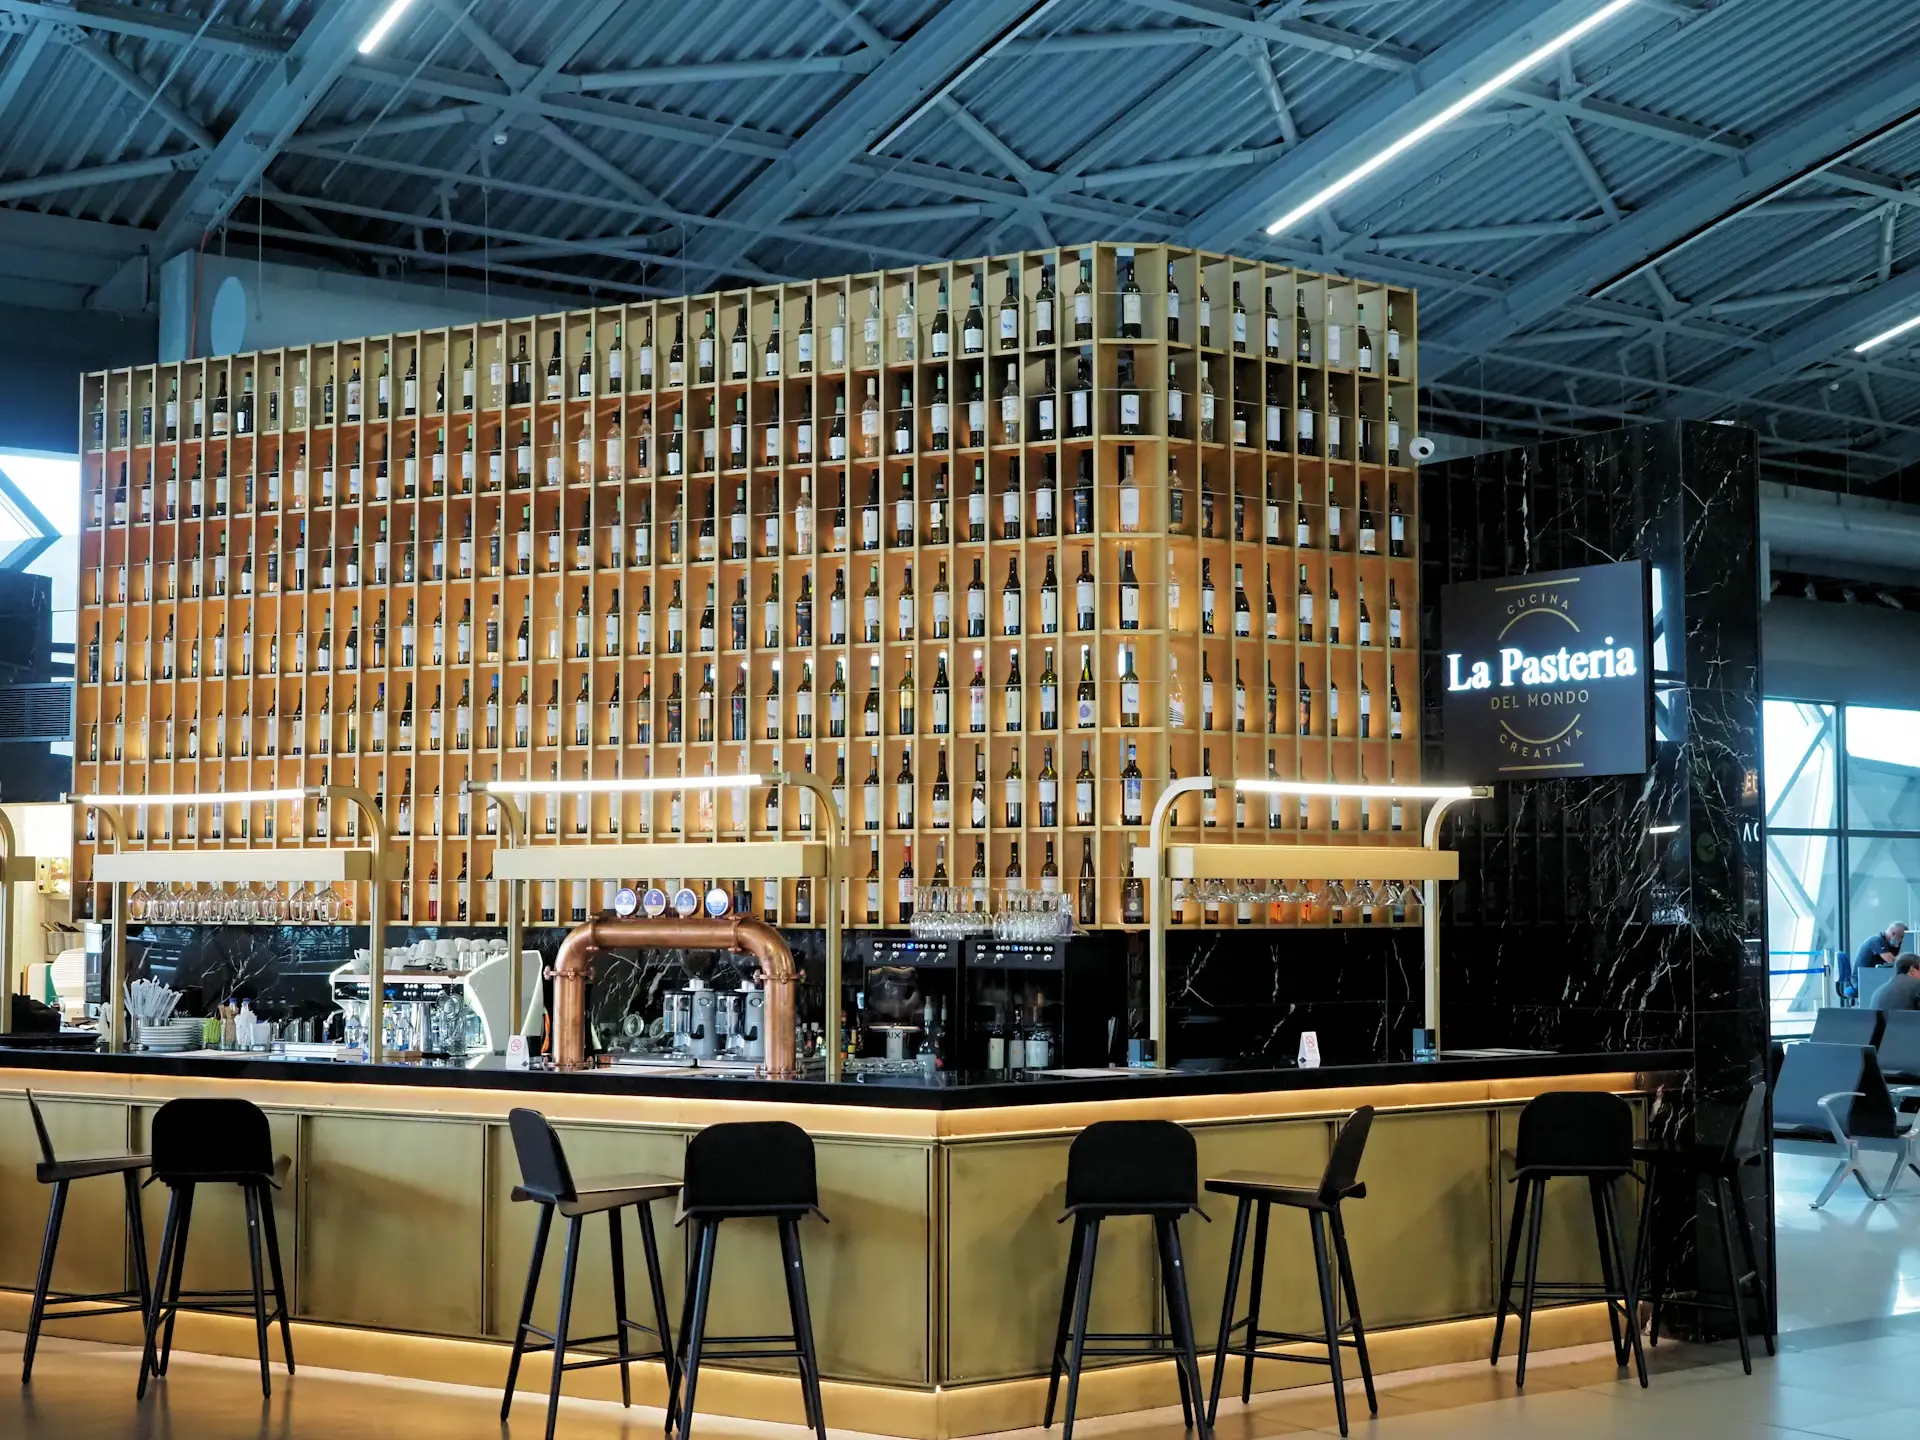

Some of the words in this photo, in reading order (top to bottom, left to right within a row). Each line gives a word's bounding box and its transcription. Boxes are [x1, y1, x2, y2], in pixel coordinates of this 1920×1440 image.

[1507, 593, 1569, 615] CUCINA
[1447, 653, 1491, 691] La
[1500, 636, 1637, 687] Pasteria
[1491, 696, 1520, 710] DEL
[1528, 689, 1589, 707] MONDO
[1499, 728, 1584, 759] CREATIVA
